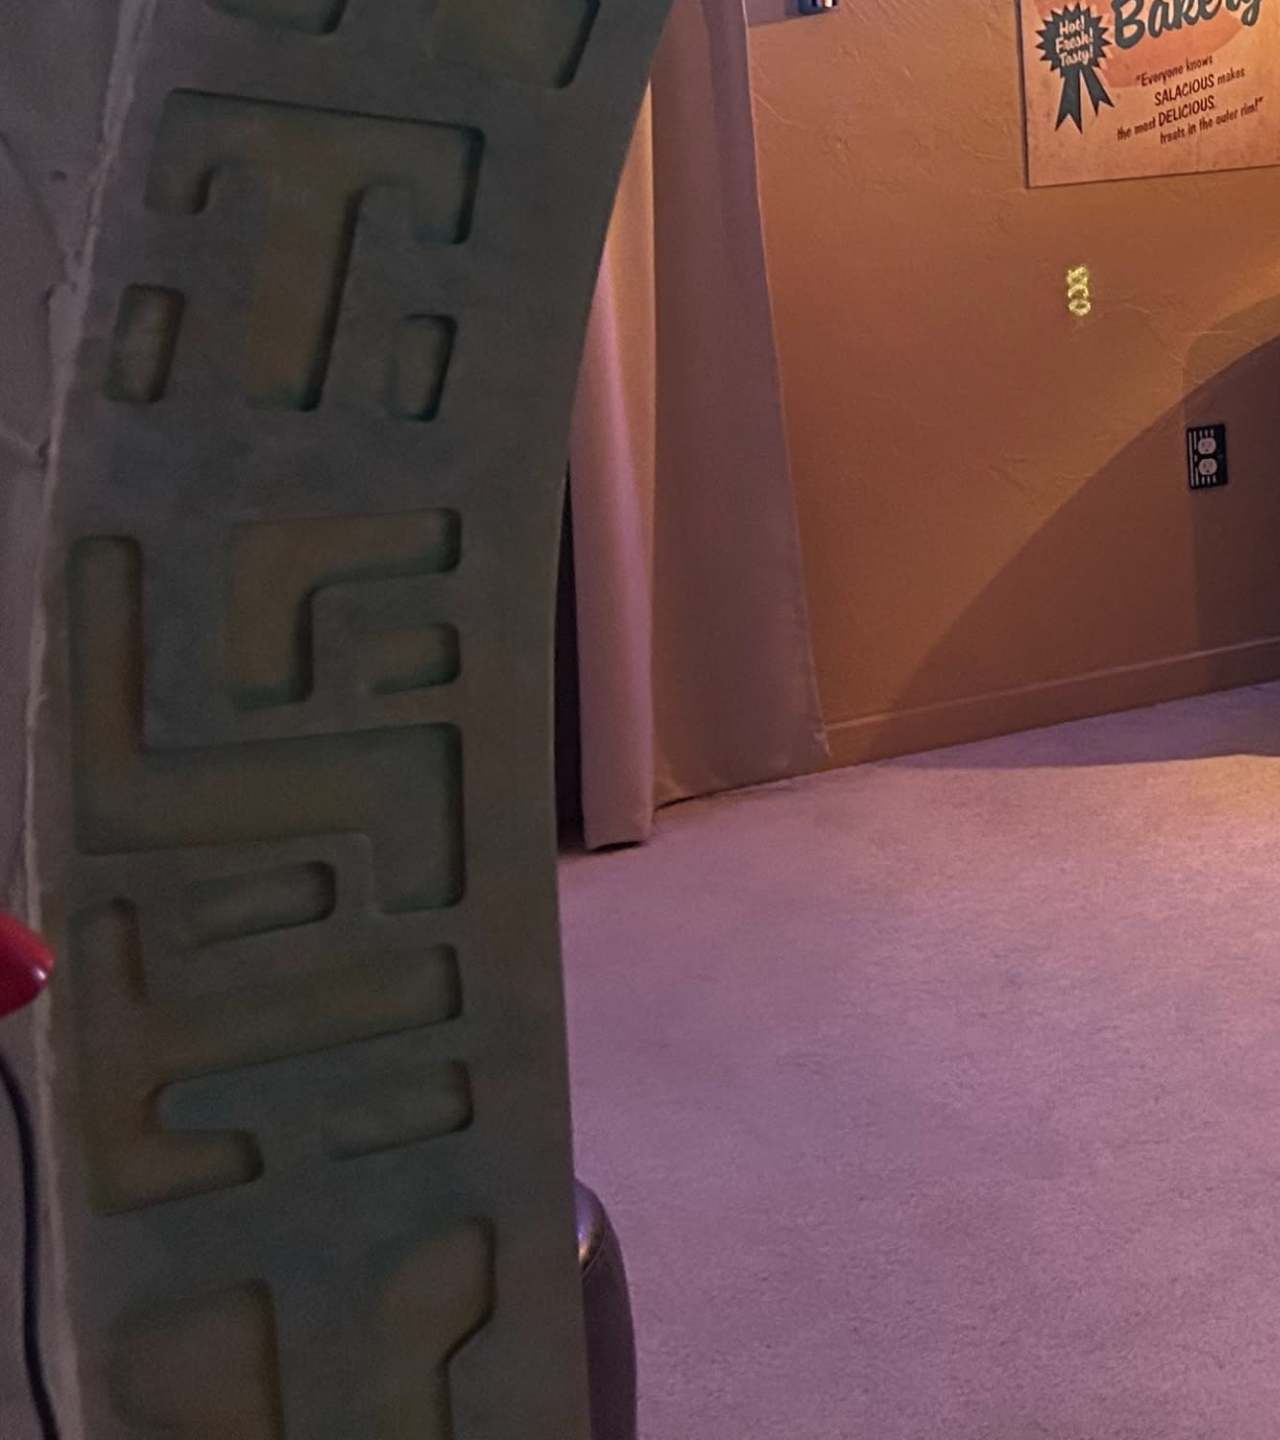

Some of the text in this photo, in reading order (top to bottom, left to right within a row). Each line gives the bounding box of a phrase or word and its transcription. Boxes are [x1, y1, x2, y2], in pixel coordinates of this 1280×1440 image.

[1055, 27, 1094, 54] Fresh!
[1059, 14, 1085, 36] Hot!
[1154, 67, 1246, 107] SALACIOUS makes
[1116, 94, 1215, 142] the most DELICIOUS
[1160, 127, 1185, 145] treats
[1187, 122, 1197, 136] in
[1199, 116, 1213, 131] the
[1215, 108, 1239, 126] outer
